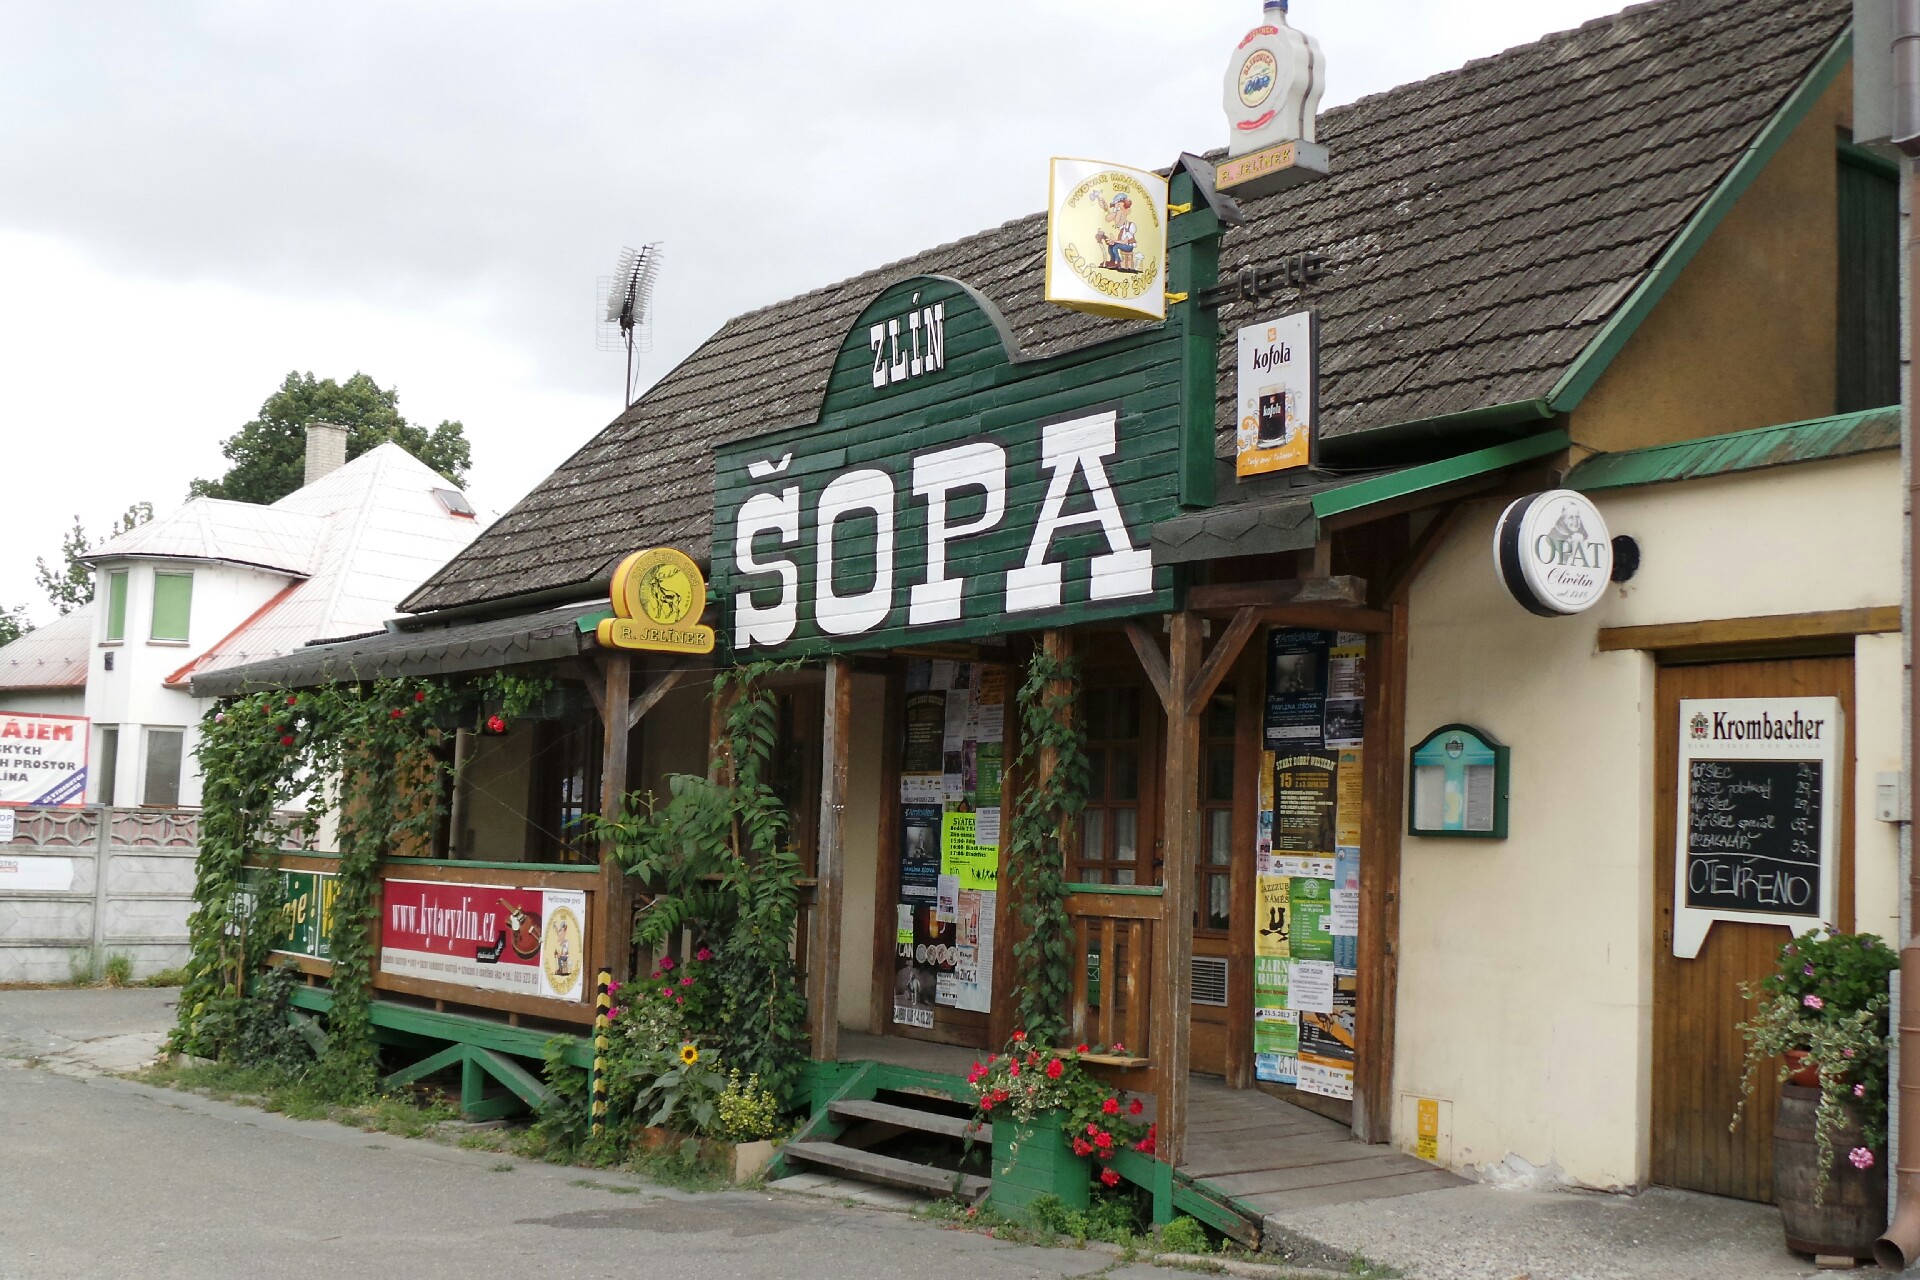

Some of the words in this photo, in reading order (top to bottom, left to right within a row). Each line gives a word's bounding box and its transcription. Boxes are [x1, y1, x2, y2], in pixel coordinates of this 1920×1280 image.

[1221, 169, 1234, 183] R.
[1236, 149, 1291, 178] JELÍNEK
[1068, 174, 1109, 209] PIVOVAR
[1064, 242, 1130, 298] ZLÍNSKÝ
[870, 292, 945, 389] ZLÍN
[1253, 341, 1291, 374] kofola
[1262, 402, 1282, 419] kofola
[735, 410, 1153, 650] ŠOPA
[1535, 534, 1605, 569] OPAT
[620, 625, 638, 641] R.
[640, 627, 707, 647] JELÍNEK
[1713, 710, 1825, 741] Krombacher
[14, 759, 76, 771] PROSTOR
[1280, 772, 1293, 788] 15
[1689, 857, 1811, 906] OTEVŘENO
[392, 893, 495, 950] www.kytaryzlin.cz
[1258, 959, 1289, 974] JARN
